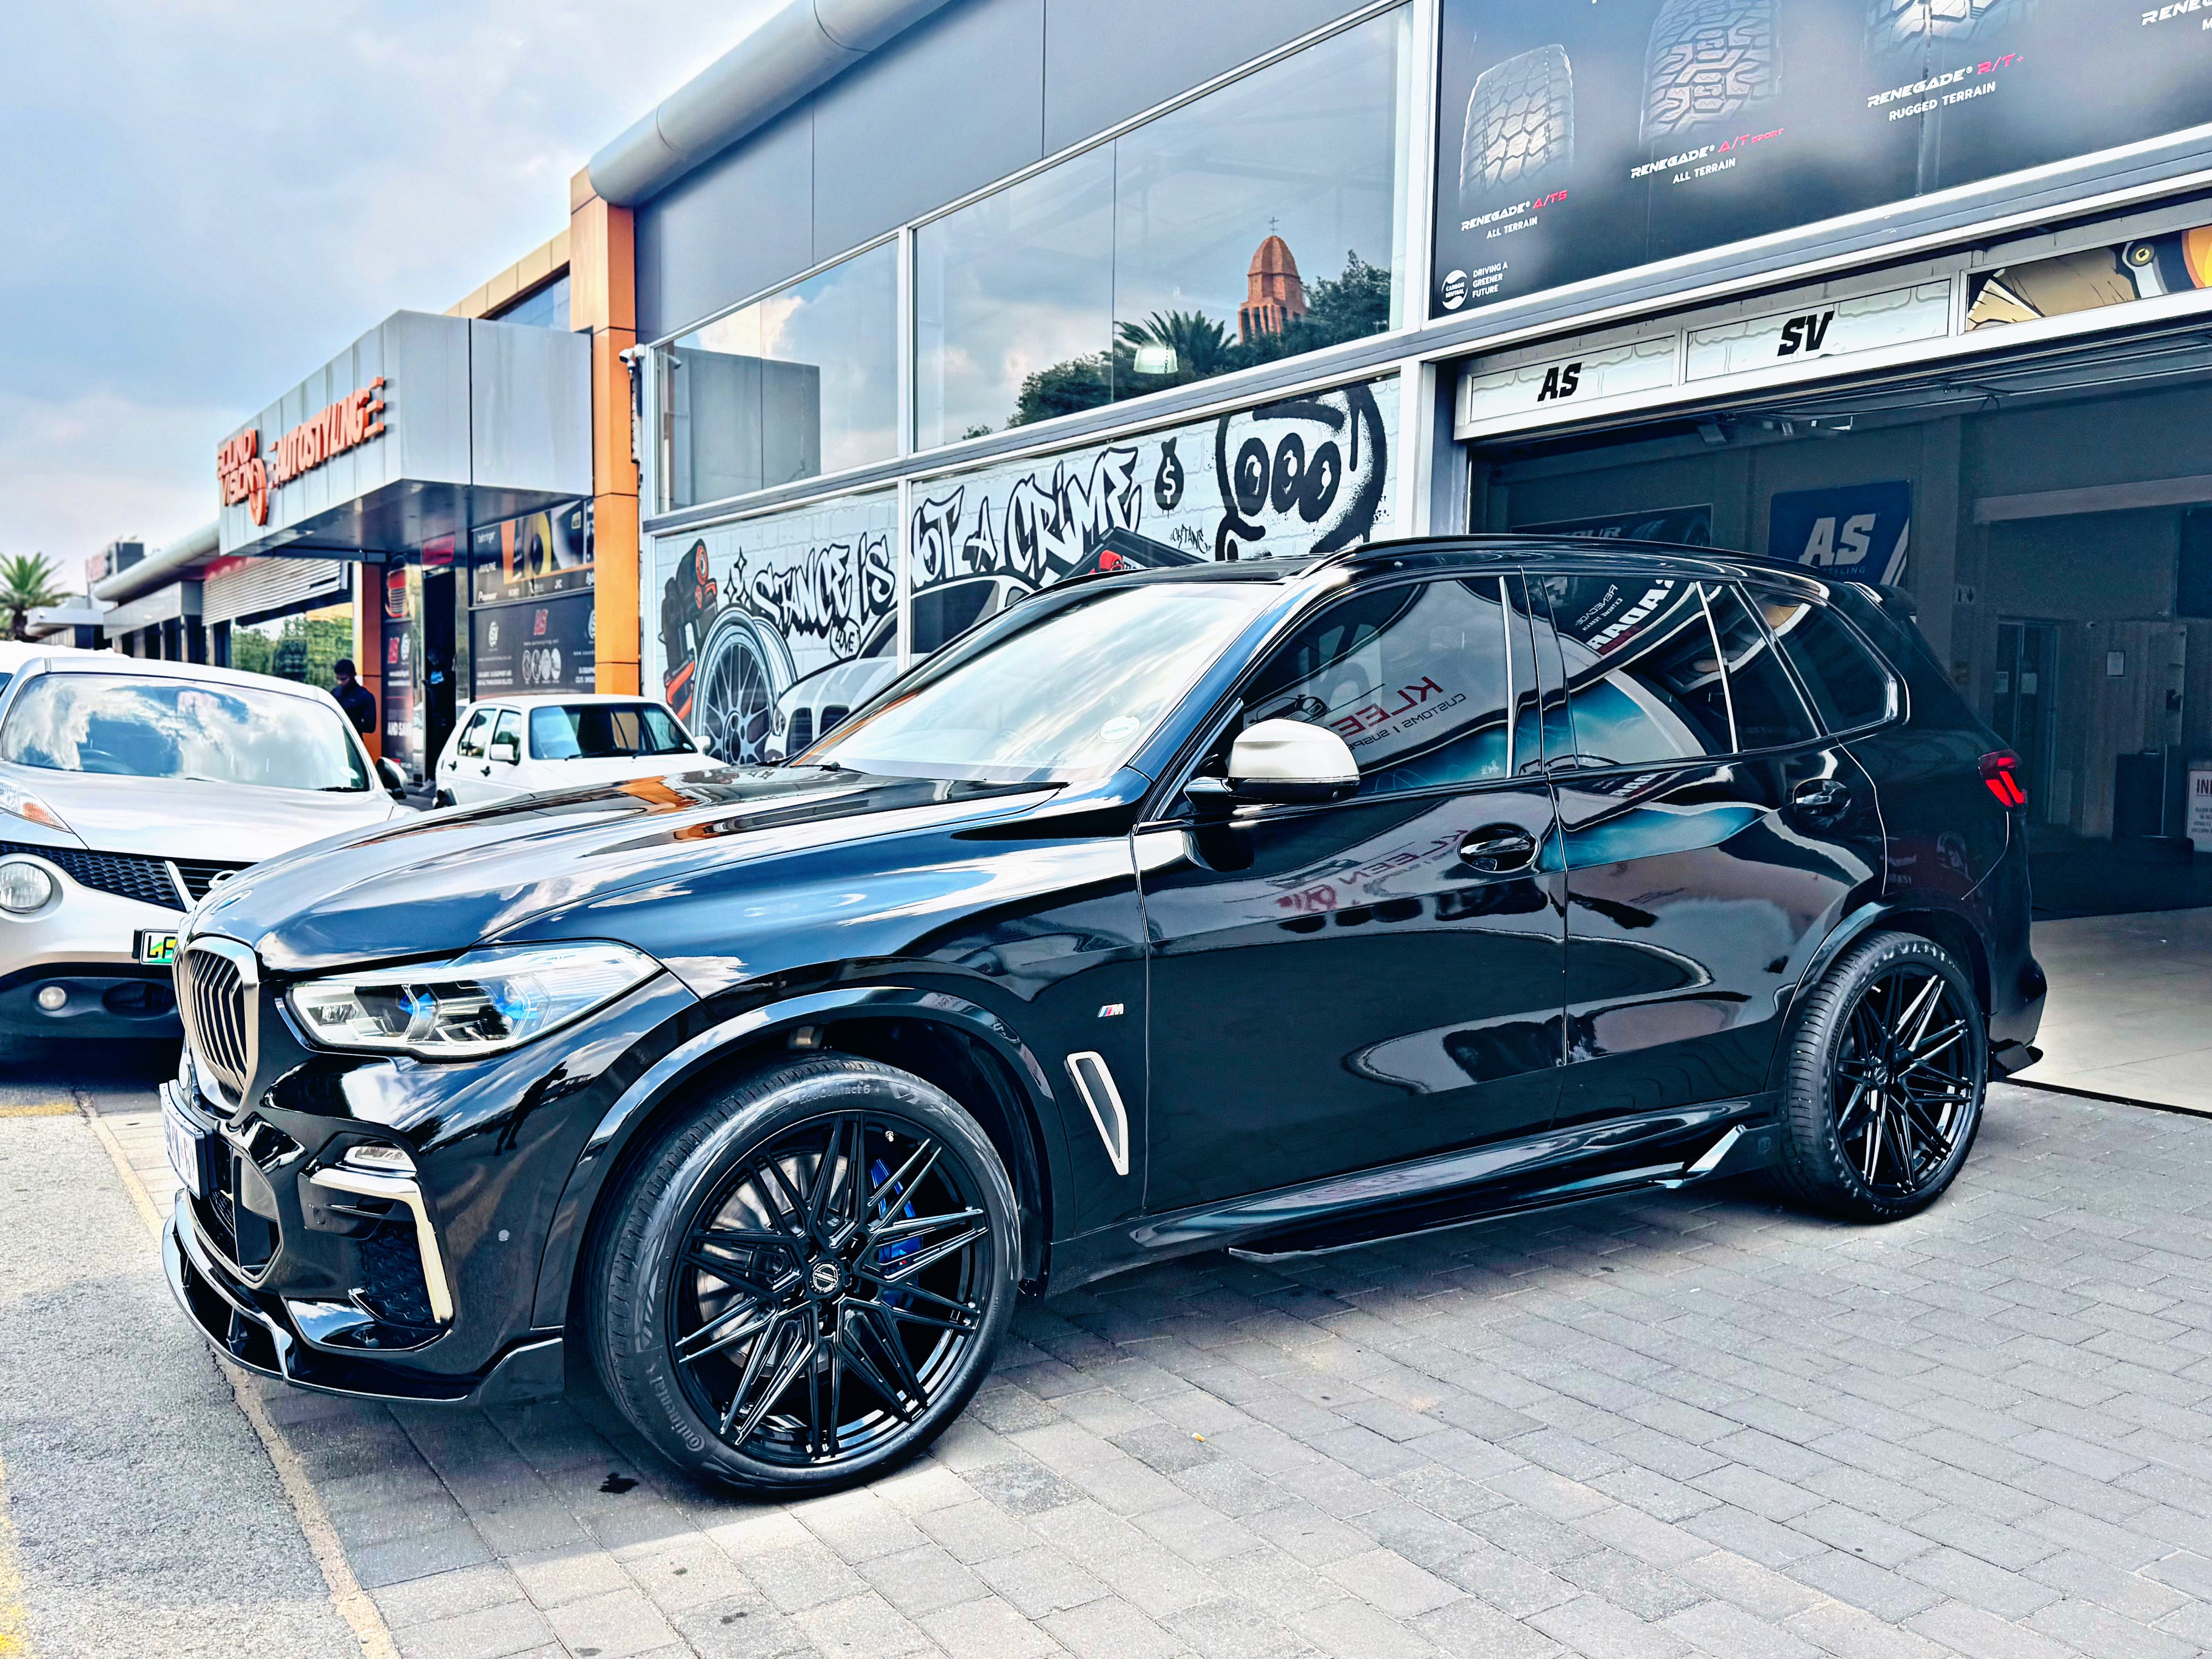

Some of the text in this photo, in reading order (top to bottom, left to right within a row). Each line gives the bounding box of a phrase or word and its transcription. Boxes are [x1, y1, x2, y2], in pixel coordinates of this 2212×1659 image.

[2141, 0, 2212, 26] RENE
[1888, 81, 1996, 121] RUGGED TERRAIN
[1751, 128, 1784, 144] SPORT
[1672, 158, 1736, 184] ALL TERRAIN
[1486, 216, 1537, 239] ALL TERRAIN
[1472, 273, 1503, 288] GREENER
[1473, 261, 1508, 278] DRIVING A
[1445, 288, 1464, 299] NEUTRAL
[1446, 282, 1465, 292] CARBON
[1472, 284, 1499, 299] FUTURE
[1777, 310, 1835, 357] SV
[1537, 362, 1582, 402] AS
[275, 389, 370, 484] AUTOSTYLING
[1798, 513, 1876, 566] AS
[835, 629, 855, 653] LOVE
